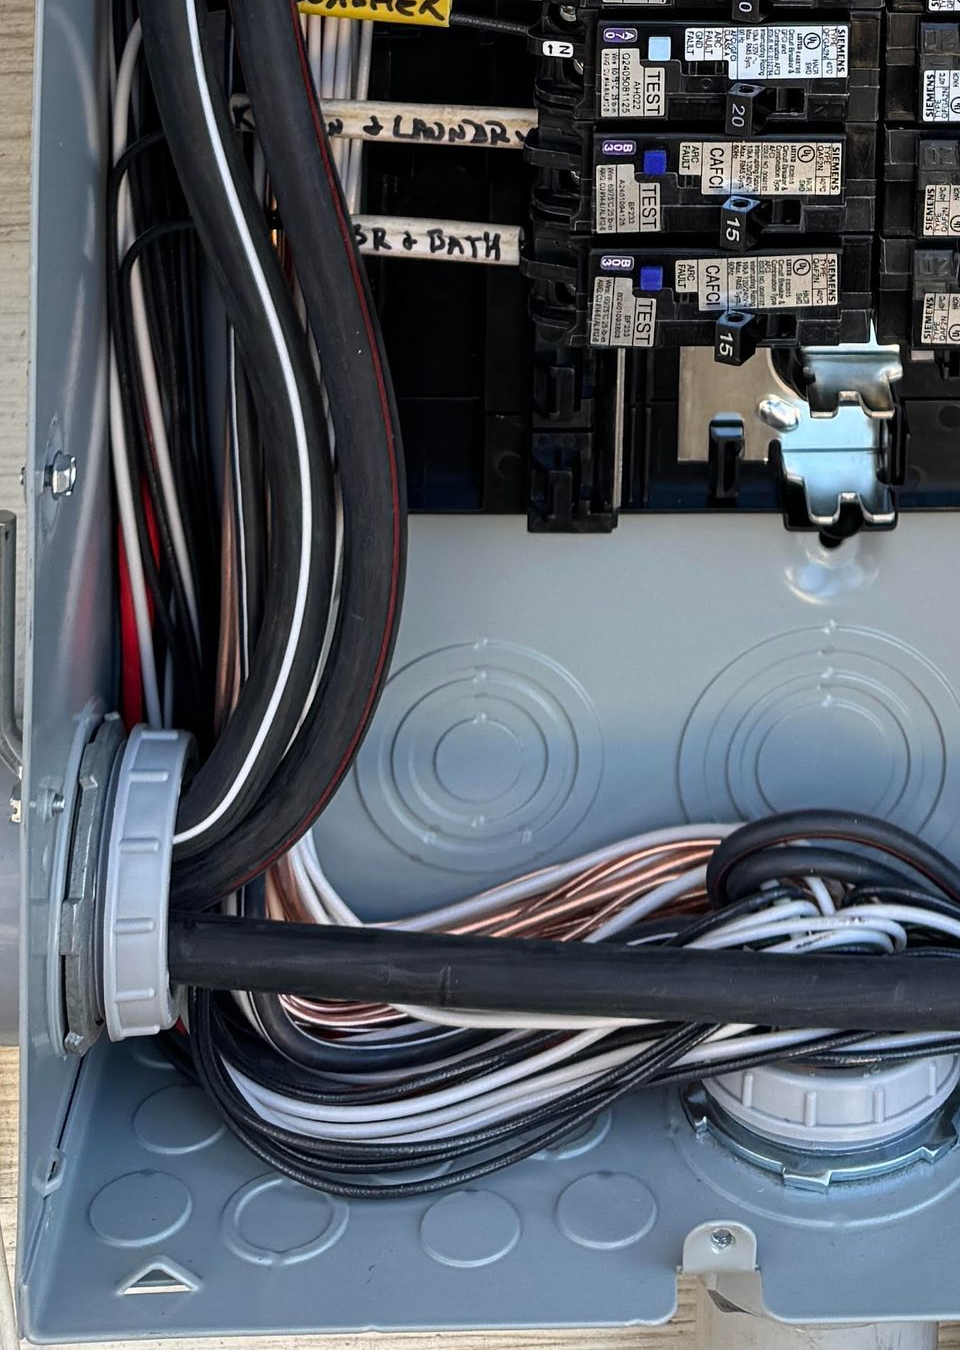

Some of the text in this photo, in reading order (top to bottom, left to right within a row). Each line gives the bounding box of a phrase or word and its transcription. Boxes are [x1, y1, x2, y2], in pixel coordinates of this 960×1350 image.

[646, 70, 661, 116] TEST
[926, 74, 936, 118] SIEMENS
[730, 103, 746, 127] 20
[708, 147, 725, 190] CAFCI
[830, 146, 841, 191] SIEMENS
[641, 183, 657, 229] TEST
[925, 188, 935, 231] SIEMENS
[427, 228, 502, 260] BATH
[725, 217, 741, 242] 15
[705, 264, 721, 307] CAFCI
[827, 258, 837, 302] SIEMENS
[635, 300, 652, 345] TEST
[923, 297, 934, 340] SIEMENS
[719, 332, 733, 357] 15
